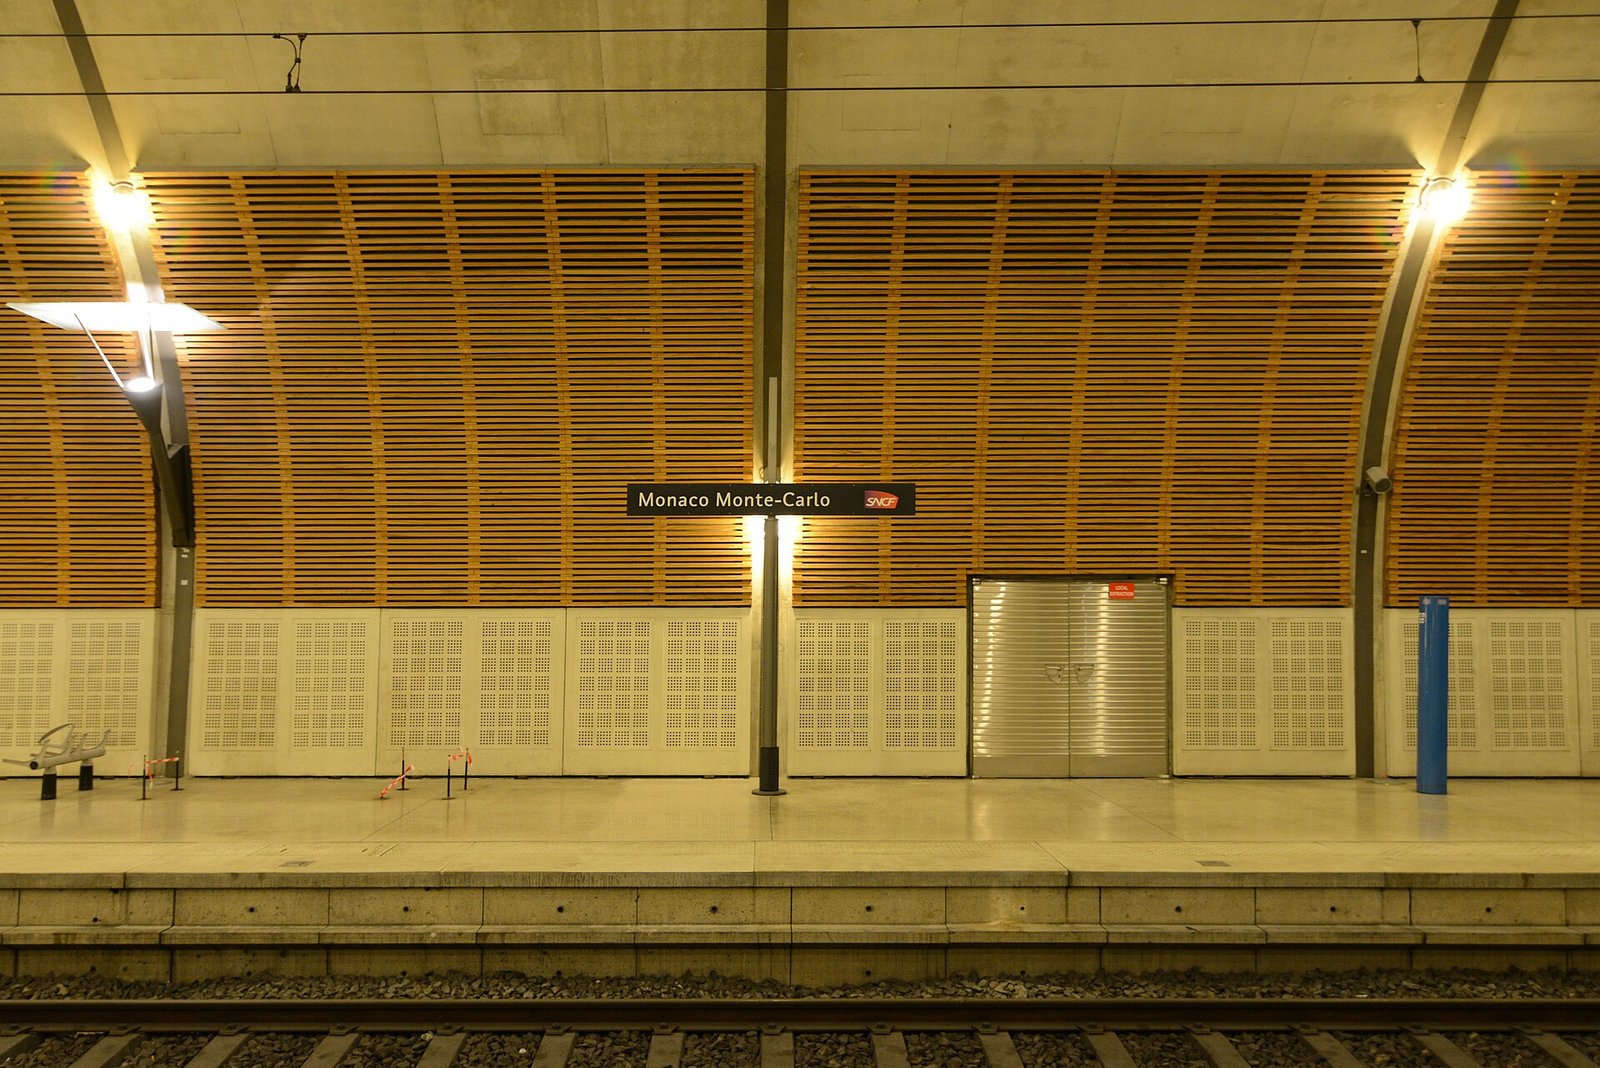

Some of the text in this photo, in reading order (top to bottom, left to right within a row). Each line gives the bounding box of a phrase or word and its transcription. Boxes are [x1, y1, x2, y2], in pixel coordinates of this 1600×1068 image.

[638, 491, 830, 507] Monaco Monte-Carlo
[865, 497, 897, 507] SNCF
